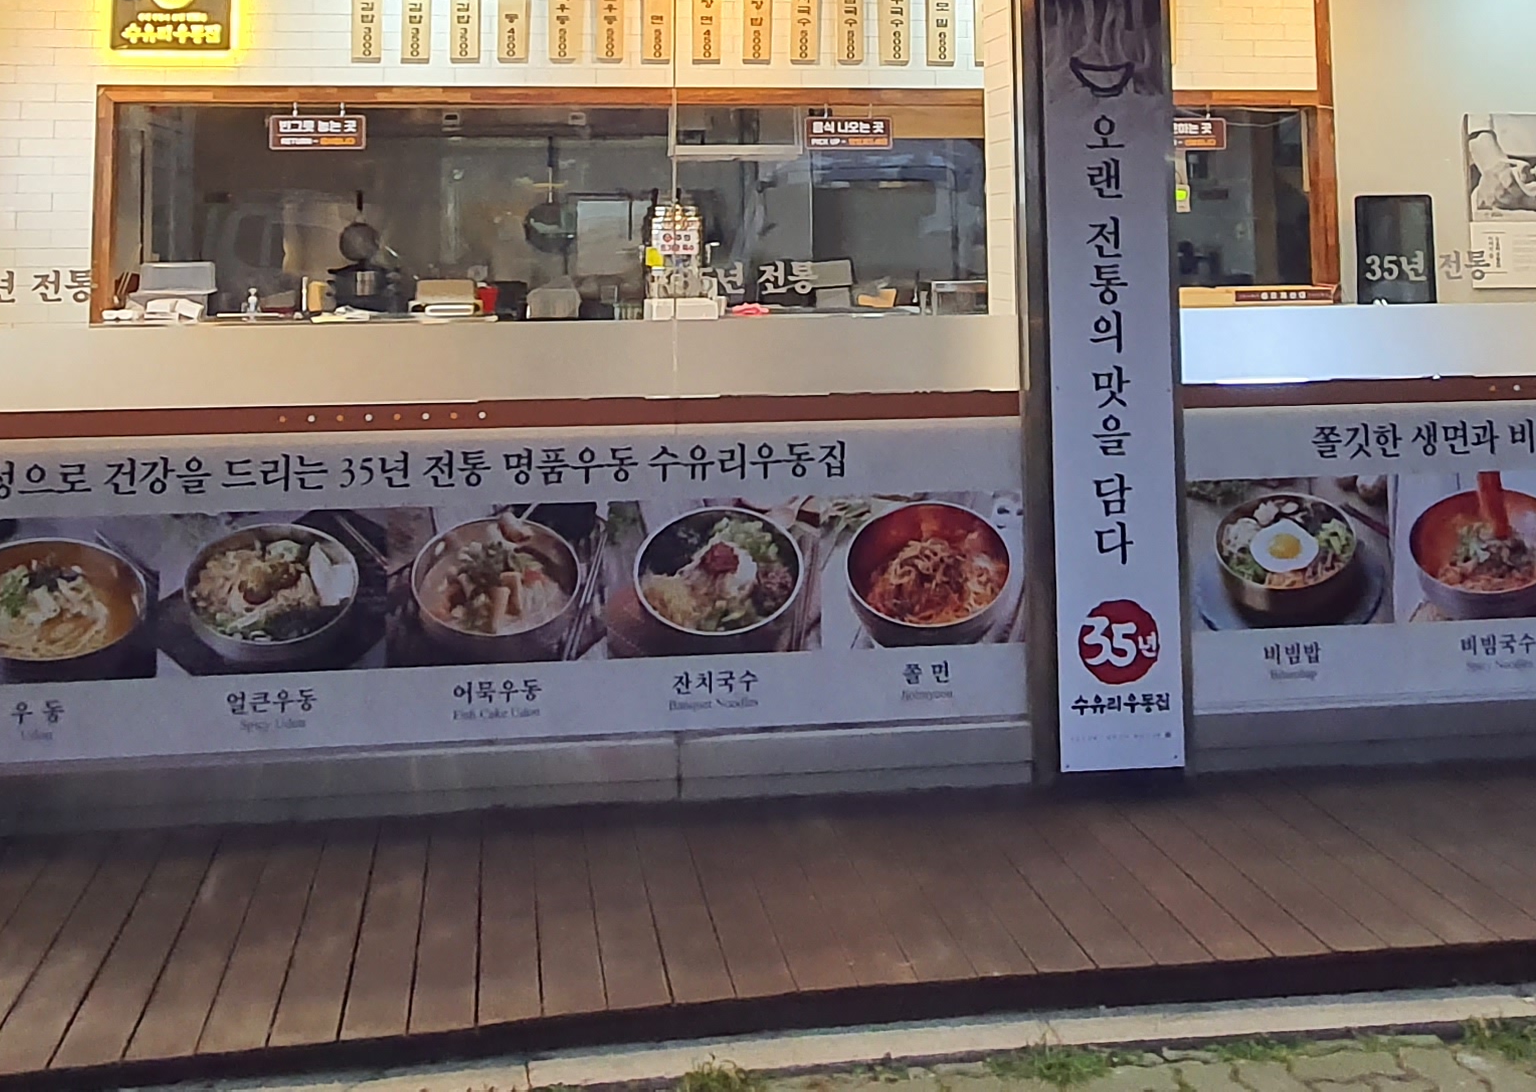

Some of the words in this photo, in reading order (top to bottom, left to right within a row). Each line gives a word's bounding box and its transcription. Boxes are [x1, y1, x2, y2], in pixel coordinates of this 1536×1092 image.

[1085, 114, 1126, 199] 오랜
[758, 260, 819, 296] 전통
[1364, 249, 1427, 282] 35년
[1438, 248, 1492, 281] 전통
[31, 269, 100, 304] 전통
[1085, 215, 1129, 355] 전통의
[1091, 364, 1132, 457] 맛을
[1310, 421, 1402, 460] 쫄깃한
[1411, 419, 1500, 458] 생면과
[103, 456, 212, 496] 건강을
[220, 452, 329, 493] 드리는
[339, 449, 411, 491] 35년
[422, 447, 492, 489] 전통
[503, 444, 640, 486] 명품우동
[647, 439, 849, 483] 수유리우동집
[1093, 473, 1134, 566] 담다
[1082, 615, 1159, 669] 35년
[1263, 641, 1322, 666] 비빔밥
[1460, 632, 1536, 657] 비빔국수
[452, 678, 543, 706] 어묵우동
[671, 670, 759, 696] 잔치국수
[226, 688, 318, 716] 얼큰우동
[1071, 692, 1170, 716] 수유리우동집
